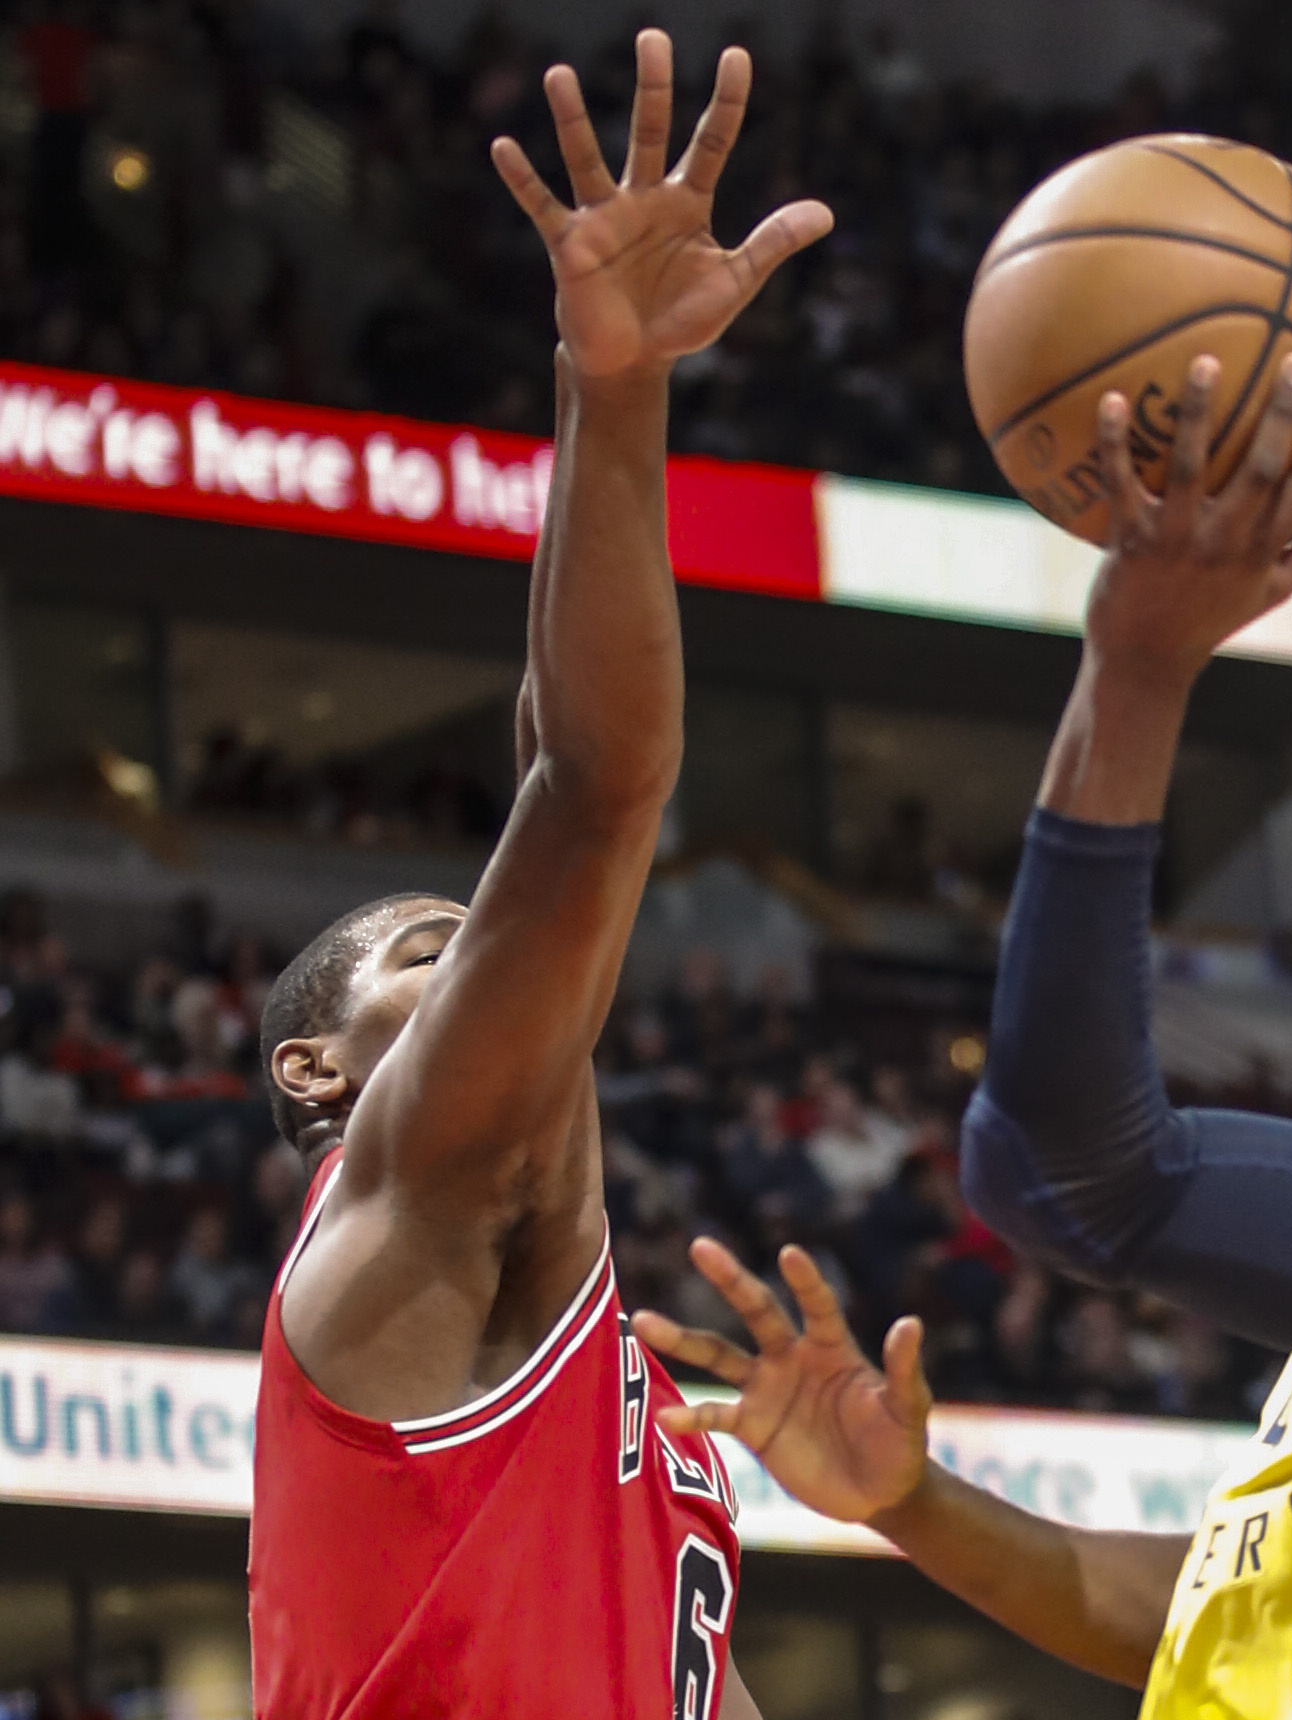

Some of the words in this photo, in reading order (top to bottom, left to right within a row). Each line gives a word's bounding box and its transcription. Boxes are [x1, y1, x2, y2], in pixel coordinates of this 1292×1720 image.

[190, 397, 356, 511] here
[363, 430, 443, 523] to
[0, 1366, 257, 1472] Unite
